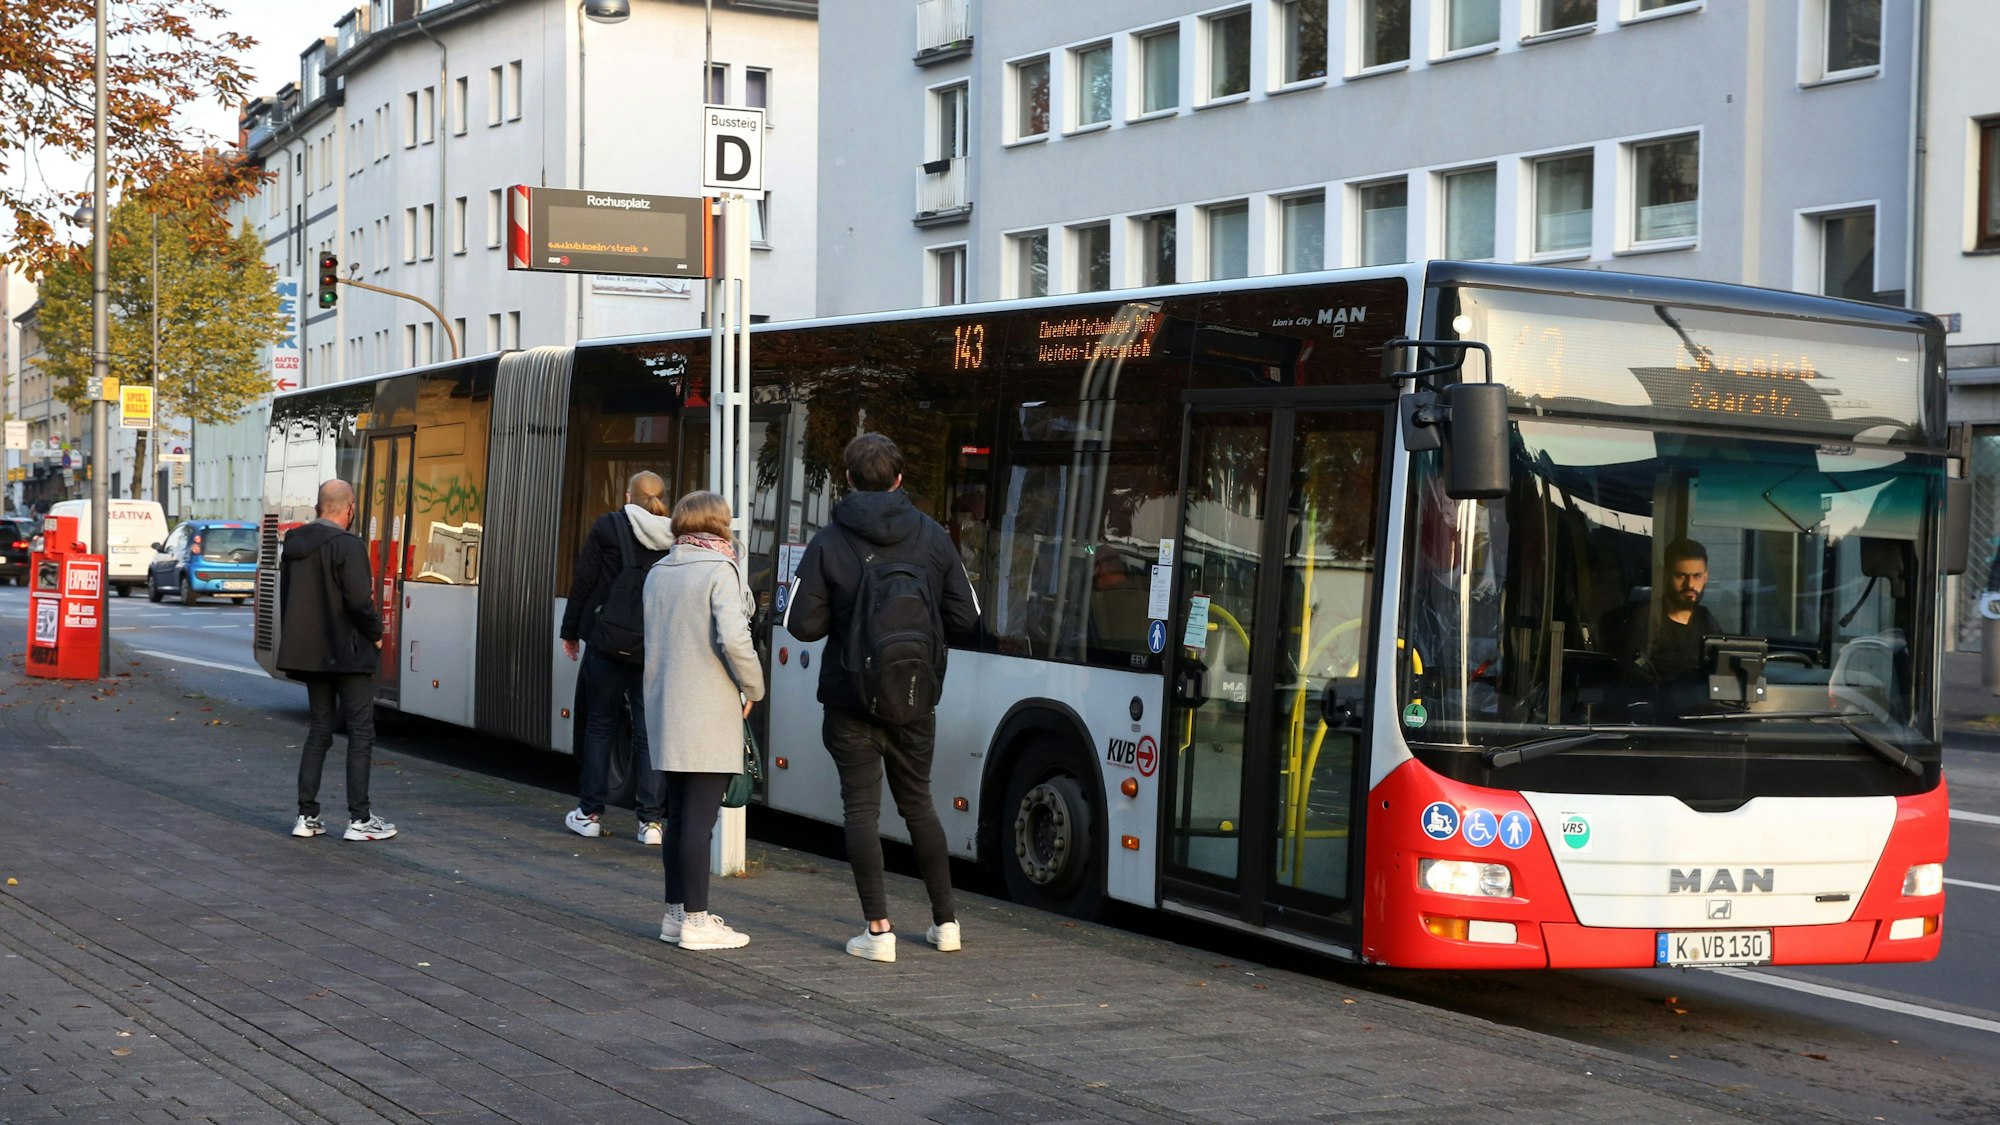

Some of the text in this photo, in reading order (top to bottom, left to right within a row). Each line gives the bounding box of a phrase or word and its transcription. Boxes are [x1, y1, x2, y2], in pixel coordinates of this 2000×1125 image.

[711, 114, 757, 132] Bussteig
[716, 134, 752, 182] D
[586, 194, 651, 210] Rochusplatz
[1272, 316, 1313, 327] Lion's City
[1316, 306, 1367, 325] MAN
[954, 324, 985, 370] 143
[126, 393, 147, 402] SPIEL
[1690, 382, 1799, 418] Saarstr.
[125, 403, 148, 413] HALLE
[107, 510, 152, 521] REATIVA
[1130, 654, 1148, 666] EEV
[1222, 681, 1246, 691] MA
[1411, 705, 1419, 716] 4
[1107, 738, 1137, 764] KVB
[1562, 822, 1584, 834] VRS
[1668, 868, 1774, 893] MAN
[1676, 936, 1688, 959] K
[1702, 935, 1725, 958] VB
[1729, 935, 1763, 958] 130
